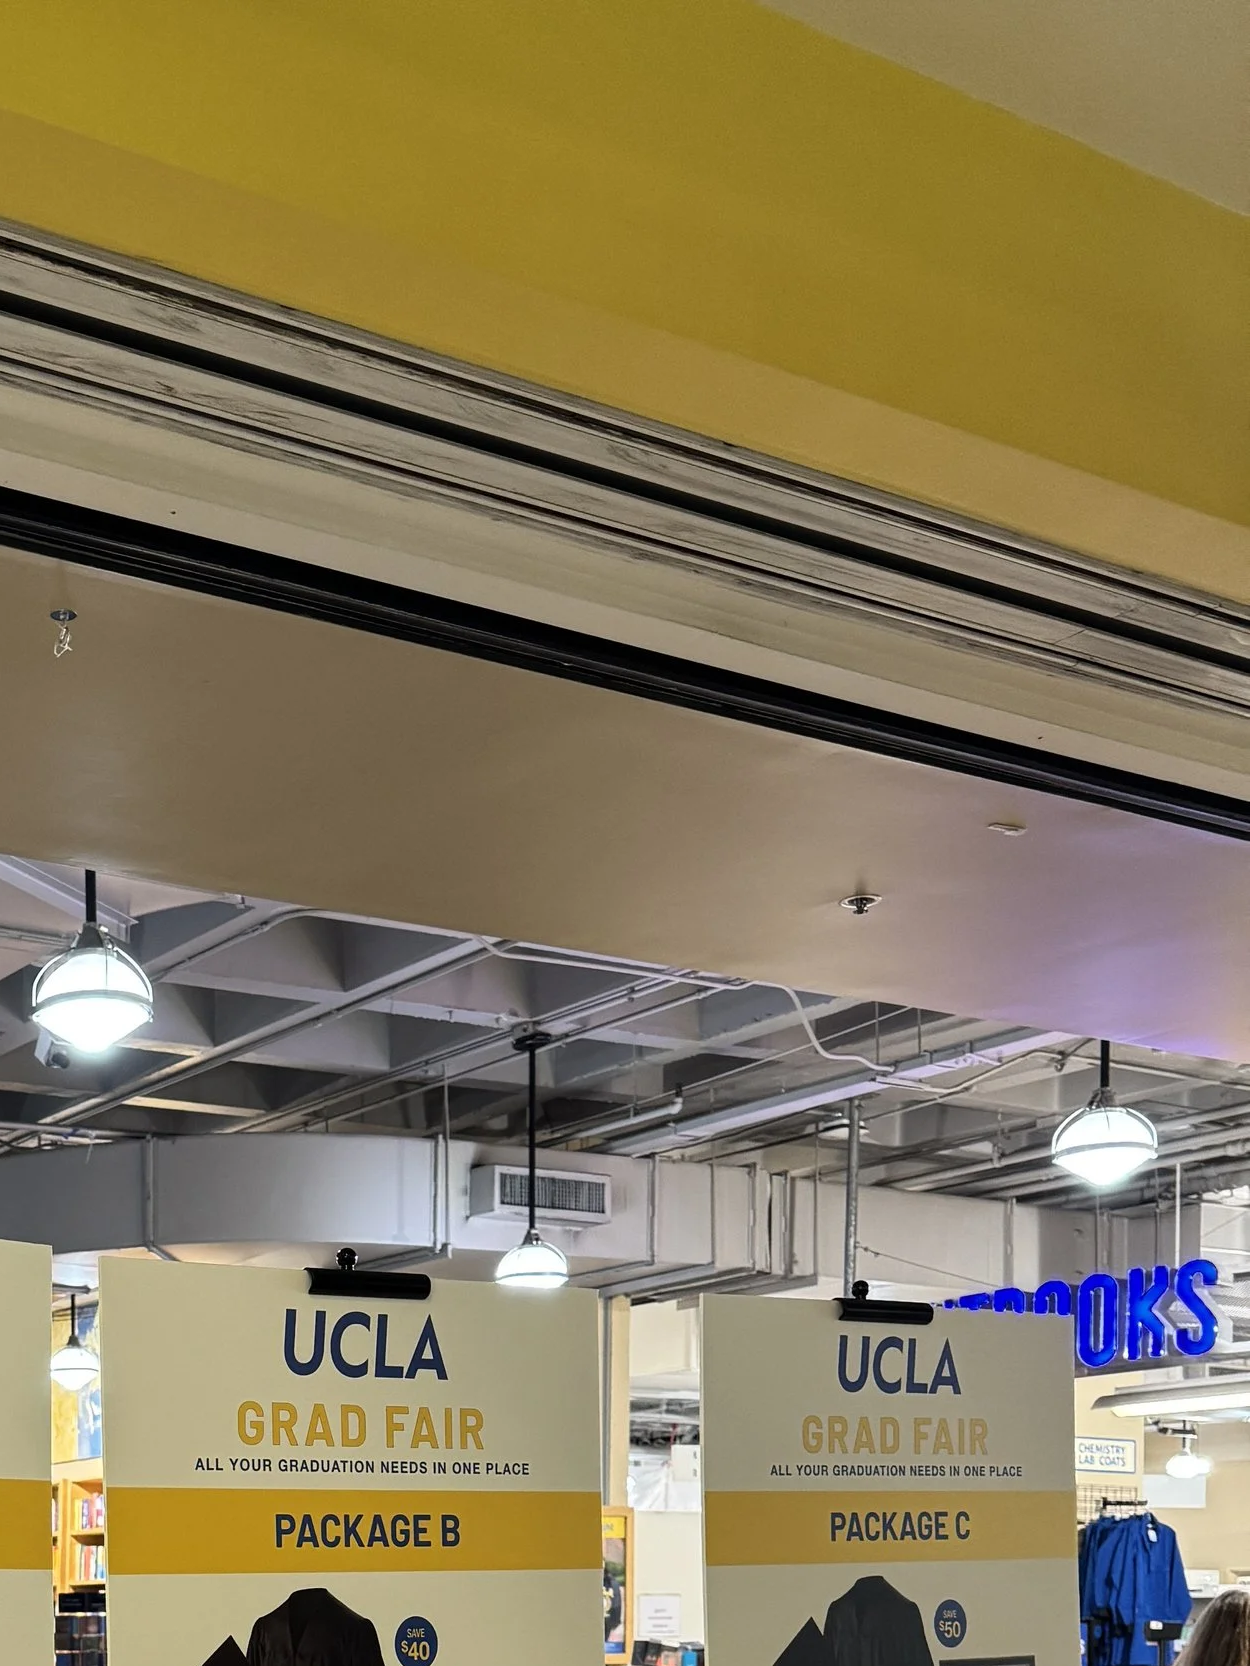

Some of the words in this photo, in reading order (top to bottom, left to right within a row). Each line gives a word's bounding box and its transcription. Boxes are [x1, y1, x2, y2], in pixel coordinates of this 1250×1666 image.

[284, 1308, 448, 1380] UCLA
[838, 1335, 961, 1395] UCLA
[237, 1401, 367, 1447] GRAD
[385, 1406, 484, 1450] FAIR
[802, 1415, 900, 1454] GRAD
[913, 1417, 988, 1456] FAIR
[195, 1458, 224, 1471] ALL
[229, 1458, 272, 1472] YOUR
[278, 1459, 374, 1473] GRADUATION
[381, 1461, 427, 1474] NEEDS
[433, 1462, 446, 1474] IN
[452, 1462, 480, 1474] ONE
[486, 1463, 529, 1475] PLACE
[1078, 1455, 1095, 1464] LAB
[770, 1465, 792, 1476] ALL
[796, 1464, 829, 1476] YOUR
[833, 1465, 906, 1476] GRADUATION
[910, 1465, 946, 1476] NEEDS
[949, 1465, 960, 1476] IN
[964, 1465, 985, 1477] ONE
[989, 1466, 1022, 1477] PLACE
[275, 1514, 431, 1548] PACKAGE
[441, 1514, 460, 1547] B
[831, 1511, 949, 1542] PACKAGE
[955, 1511, 970, 1540] C
[942, 1610, 957, 1619] SAVE
[407, 1628, 425, 1638] SAVE
[939, 1621, 961, 1638] $50
[401, 1640, 429, 1660] $40
